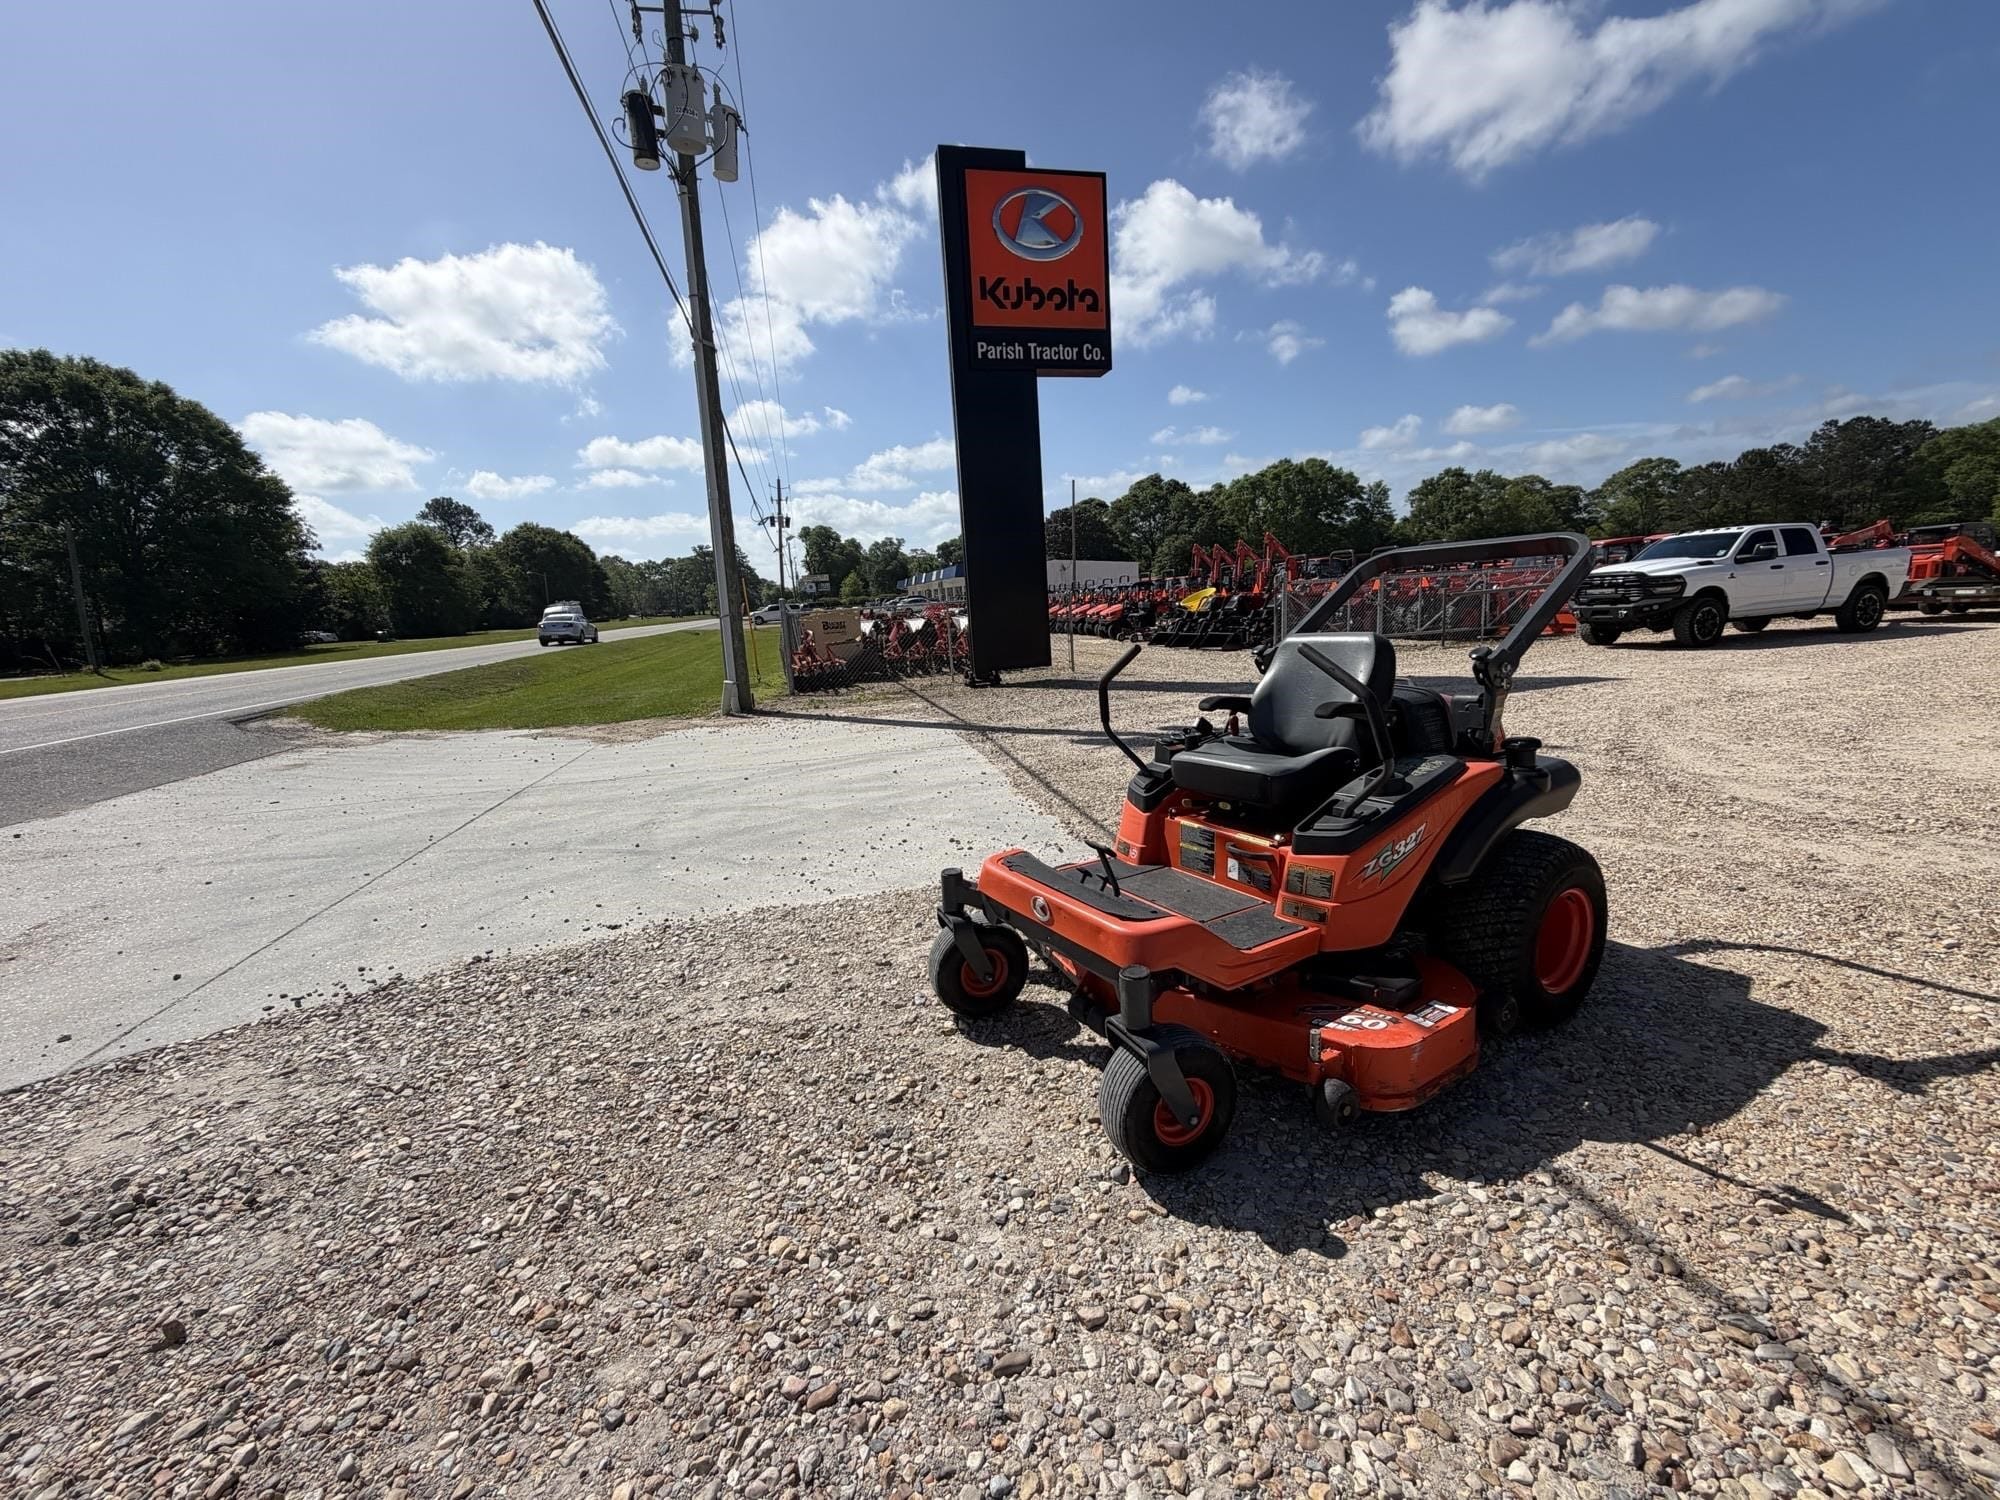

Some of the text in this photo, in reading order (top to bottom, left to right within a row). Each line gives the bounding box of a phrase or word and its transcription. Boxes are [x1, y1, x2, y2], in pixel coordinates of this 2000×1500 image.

[979, 276, 1099, 313] Kubota
[977, 342, 1106, 361] Parish Tractor Co.
[1340, 1014, 1388, 1031] 60
